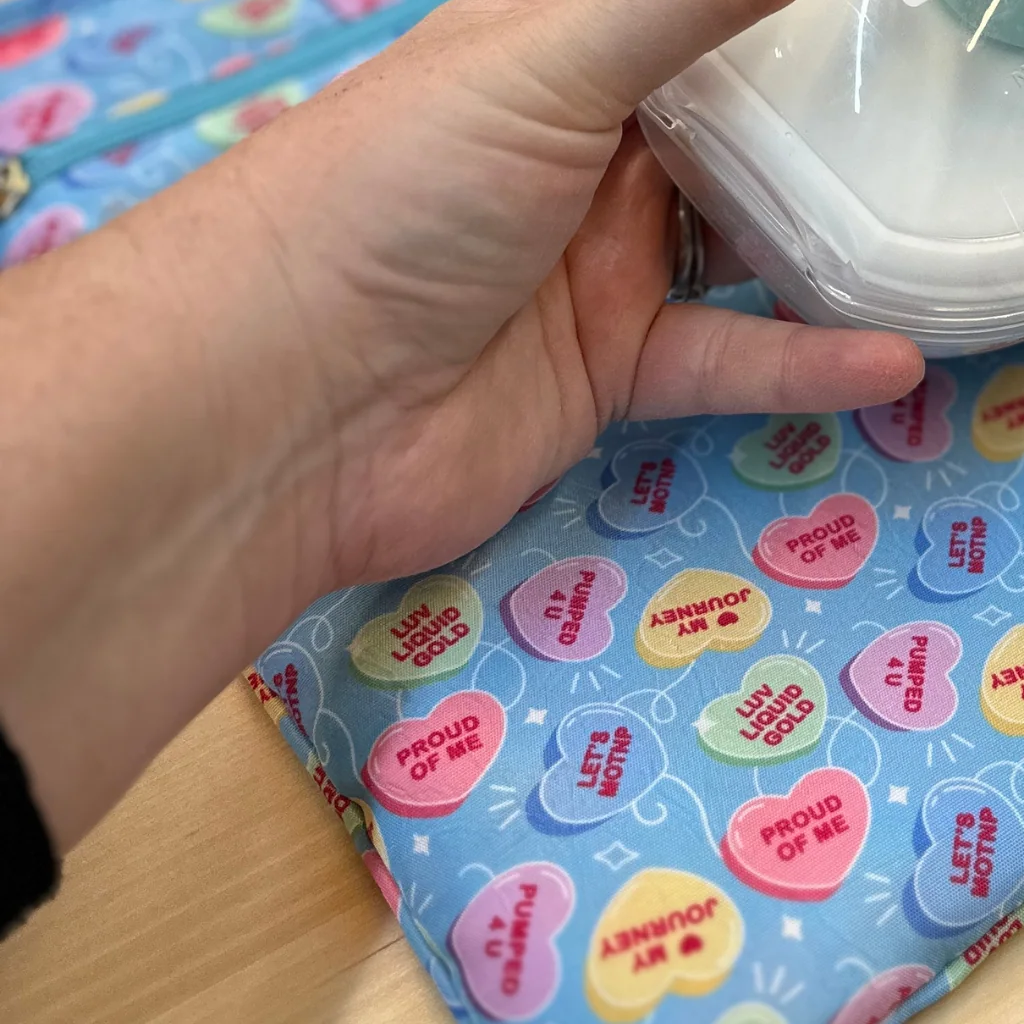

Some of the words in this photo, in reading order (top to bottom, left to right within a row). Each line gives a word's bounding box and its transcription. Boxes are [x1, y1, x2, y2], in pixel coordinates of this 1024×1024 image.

[763, 422, 797, 452] LUV
[768, 421, 822, 471] LIQUID
[788, 434, 832, 476] GOLD
[785, 514, 856, 554] PROUD
[799, 541, 826, 564] OF
[833, 528, 862, 552] ME
[948, 520, 968, 569] LET'S
[967, 516, 988, 574] MOTNP
[543, 606, 564, 621] U
[549, 589, 567, 604] 4
[557, 569, 596, 646] PUMPED
[649, 587, 751, 628] JOURNEY
[390, 603, 432, 640] LUV
[391, 606, 462, 663] LIQUID
[412, 622, 471, 668] GOLD
[677, 618, 709, 638] MY
[884, 673, 903, 689] U
[886, 656, 904, 671] 4
[903, 634, 929, 714] PUMPED
[735, 682, 774, 719] LUV
[740, 683, 804, 742] LIQUID
[763, 698, 816, 747] GOLD
[396, 714, 481, 768] PROUD
[410, 752, 441, 782] OF
[446, 732, 484, 762] ME
[576, 730, 610, 789] LET'S
[597, 725, 634, 799] MOTNP
[759, 794, 844, 847] PROUD
[776, 831, 810, 863] OF
[815, 814, 850, 844] ME
[949, 812, 976, 885] LET'S
[970, 806, 998, 898] MOTNP
[488, 915, 507, 932] 4
[501, 883, 538, 997] PUMPED
[600, 897, 719, 962] JOURNEY
[484, 939, 503, 959] U
[631, 944, 668, 974] MY
